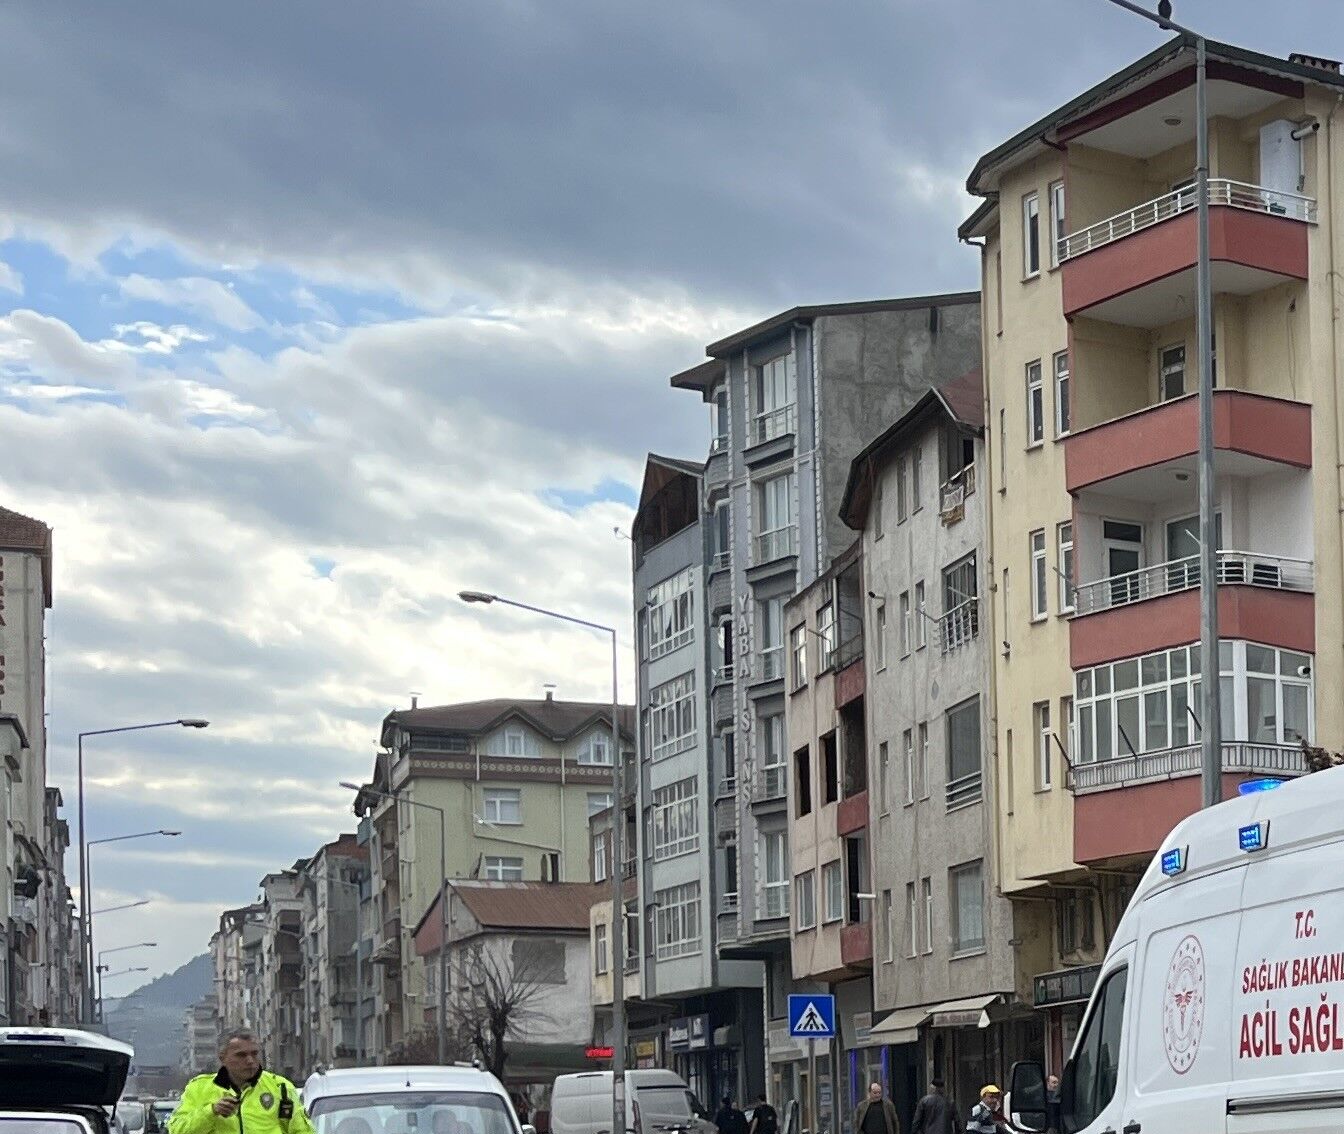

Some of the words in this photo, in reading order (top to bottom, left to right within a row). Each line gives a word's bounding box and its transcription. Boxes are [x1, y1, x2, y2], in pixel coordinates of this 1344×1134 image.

[1295, 909, 1317, 939] T.C.
[1242, 958, 1288, 994] SAĞLIK
[1239, 999, 1282, 1059] ACİL
